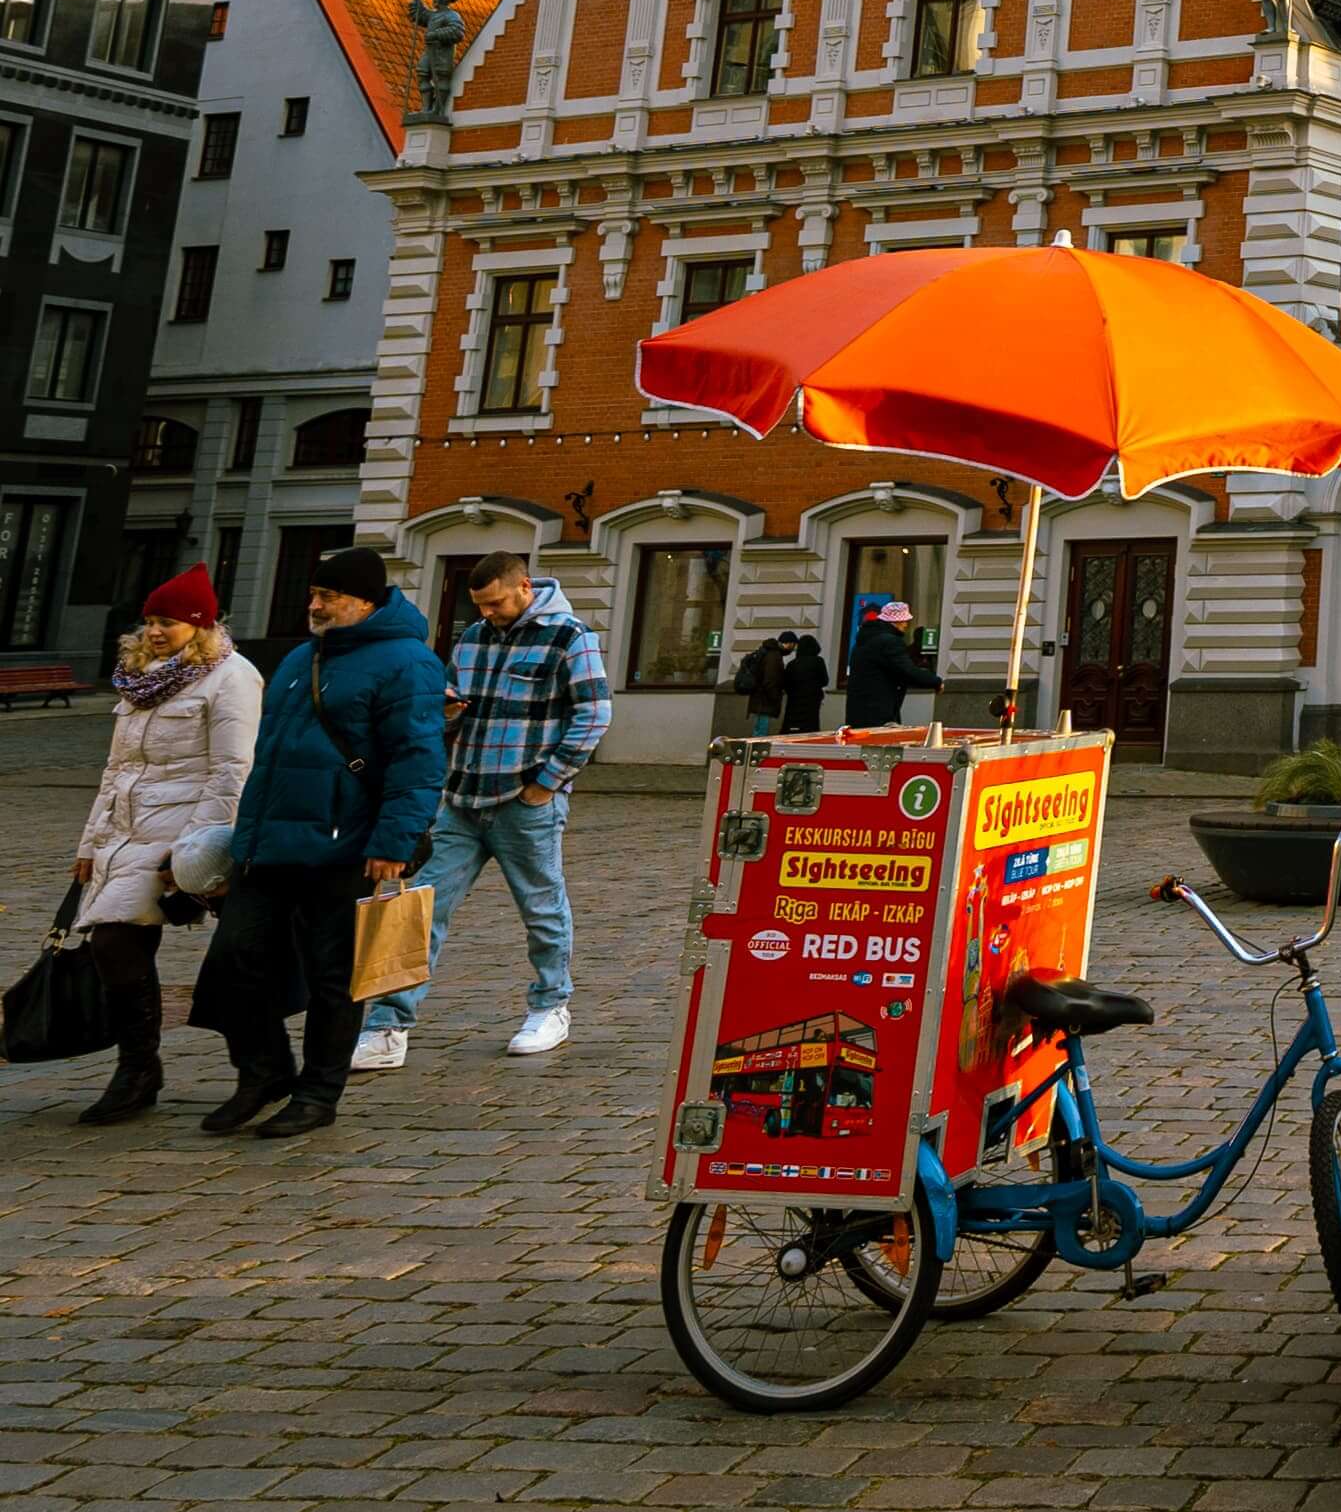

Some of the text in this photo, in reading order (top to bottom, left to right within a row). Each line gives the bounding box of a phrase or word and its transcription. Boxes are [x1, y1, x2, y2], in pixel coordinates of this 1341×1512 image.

[982, 783, 1090, 838] Sightseeing
[784, 827, 936, 850] EKSKURSIJA PA RĪGU
[786, 856, 926, 888] Sightseeing
[829, 901, 870, 922] IEKĀP
[882, 902, 925, 924] IZKĀP
[747, 940, 792, 951] OFFICIAL
[802, 933, 921, 963] RED BUS
